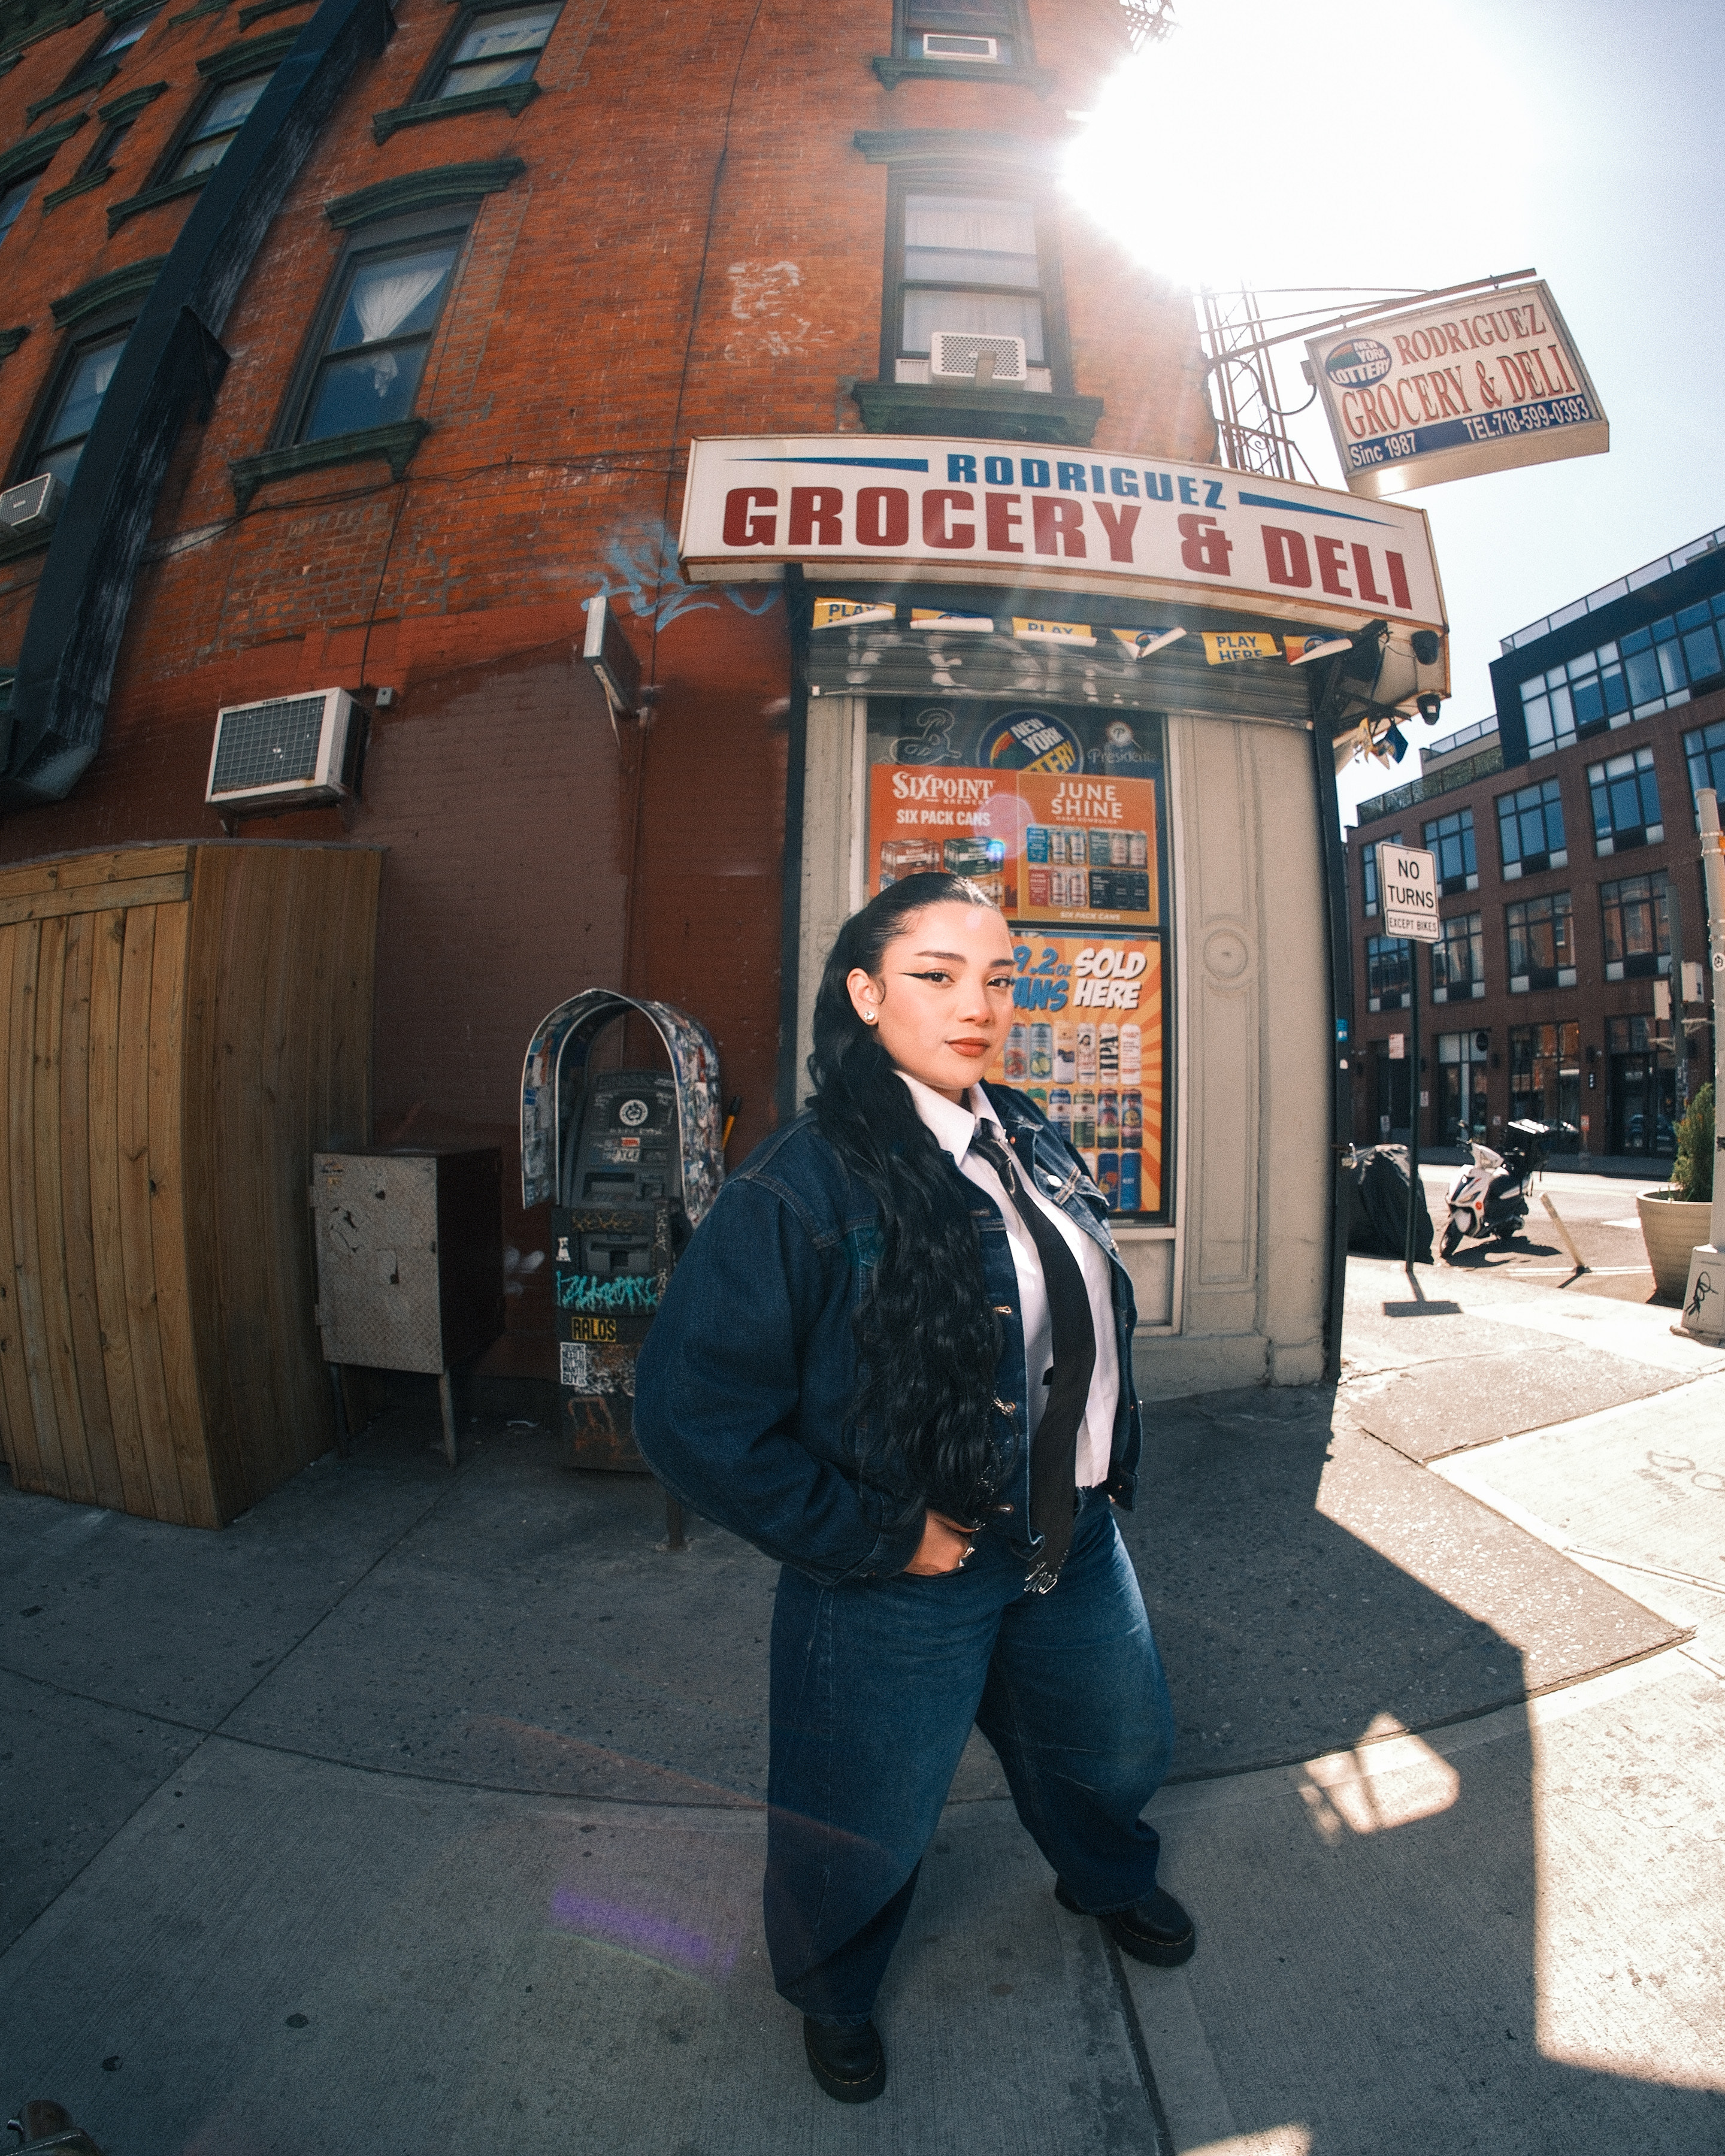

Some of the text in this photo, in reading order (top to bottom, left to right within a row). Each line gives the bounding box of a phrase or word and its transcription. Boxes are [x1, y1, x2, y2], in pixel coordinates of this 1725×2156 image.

[1353, 340, 1378, 351] NEW
[1393, 304, 1547, 366] RODRIGUEZ
[1356, 348, 1387, 363] YORK
[1329, 358, 1391, 384] LOTTERY
[1342, 344, 1575, 440] GROCERY & DELI
[1384, 432, 1417, 458] 1987
[948, 453, 1226, 511] RODRIGUEZ
[722, 486, 1413, 611] GROCERY & DELI
[1216, 635, 1257, 648] PLAY
[1010, 717, 1045, 740] NEW
[1021, 726, 1065, 756] YORK
[1056, 782, 1117, 801] JUNE
[896, 808, 991, 826] SIX PACK CANS
[1051, 798, 1123, 819] SHINE
[1397, 858, 1420, 880] NO
[1387, 885, 1435, 909] TURNS
[1098, 912, 1121, 921] CANS
[1389, 917, 1437, 932] EXCEPT BIKES
[1013, 944, 1059, 975] 9.2
[1075, 947, 1147, 980] SOLD
[1011, 976, 1070, 1012] ANS
[1073, 978, 1142, 1010] HERE
